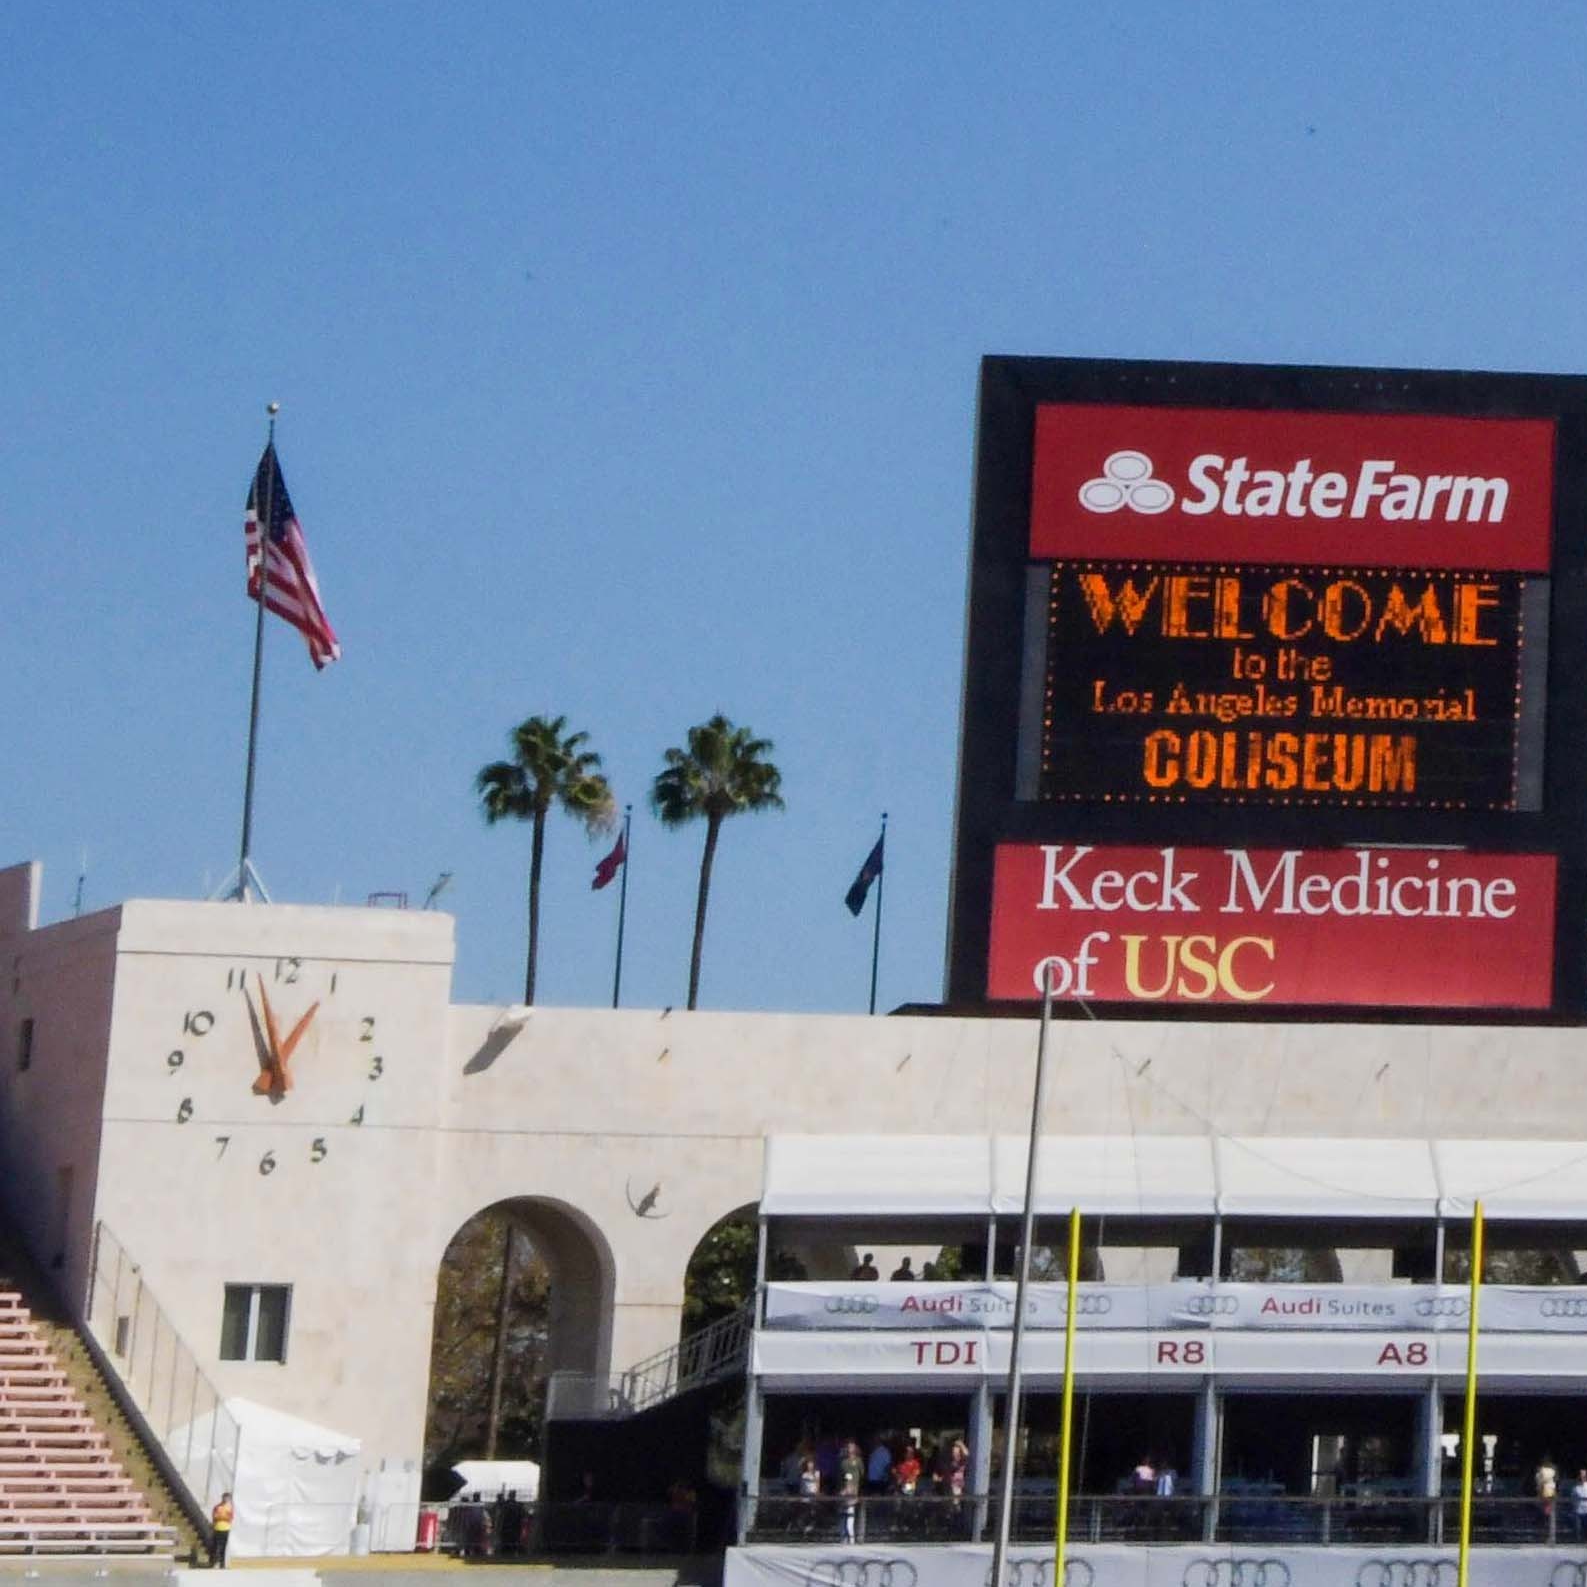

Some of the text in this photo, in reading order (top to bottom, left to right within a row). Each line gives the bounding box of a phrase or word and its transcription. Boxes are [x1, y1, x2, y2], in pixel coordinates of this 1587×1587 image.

[1078, 574, 1499, 645] WELCOME
[1232, 646, 1333, 681] to the
[1092, 680, 1477, 723] Los Angeles Memorial
[1143, 728, 1417, 793] COLISEUM
[1035, 846, 1516, 919] Keck Medicine
[274, 957, 302, 984] 12
[1032, 931, 1276, 1001] of USC
[226, 967, 247, 992] 11
[329, 972, 337, 995] 1
[183, 1010, 215, 1037] 10
[359, 1016, 375, 1042] 2
[167, 1049, 185, 1076] 9
[367, 1055, 384, 1081] 3
[177, 1097, 194, 1124] 8
[349, 1104, 365, 1127] 4
[215, 1136, 231, 1161] 7
[310, 1137, 328, 1163] 5
[258, 1149, 276, 1176] 6
[900, 1294, 1038, 1314] Audi Suits
[1260, 1296, 1396, 1317] Audi Suites
[909, 1340, 979, 1365] TDI
[1156, 1340, 1205, 1365] R8
[1377, 1342, 1429, 1366] A8
